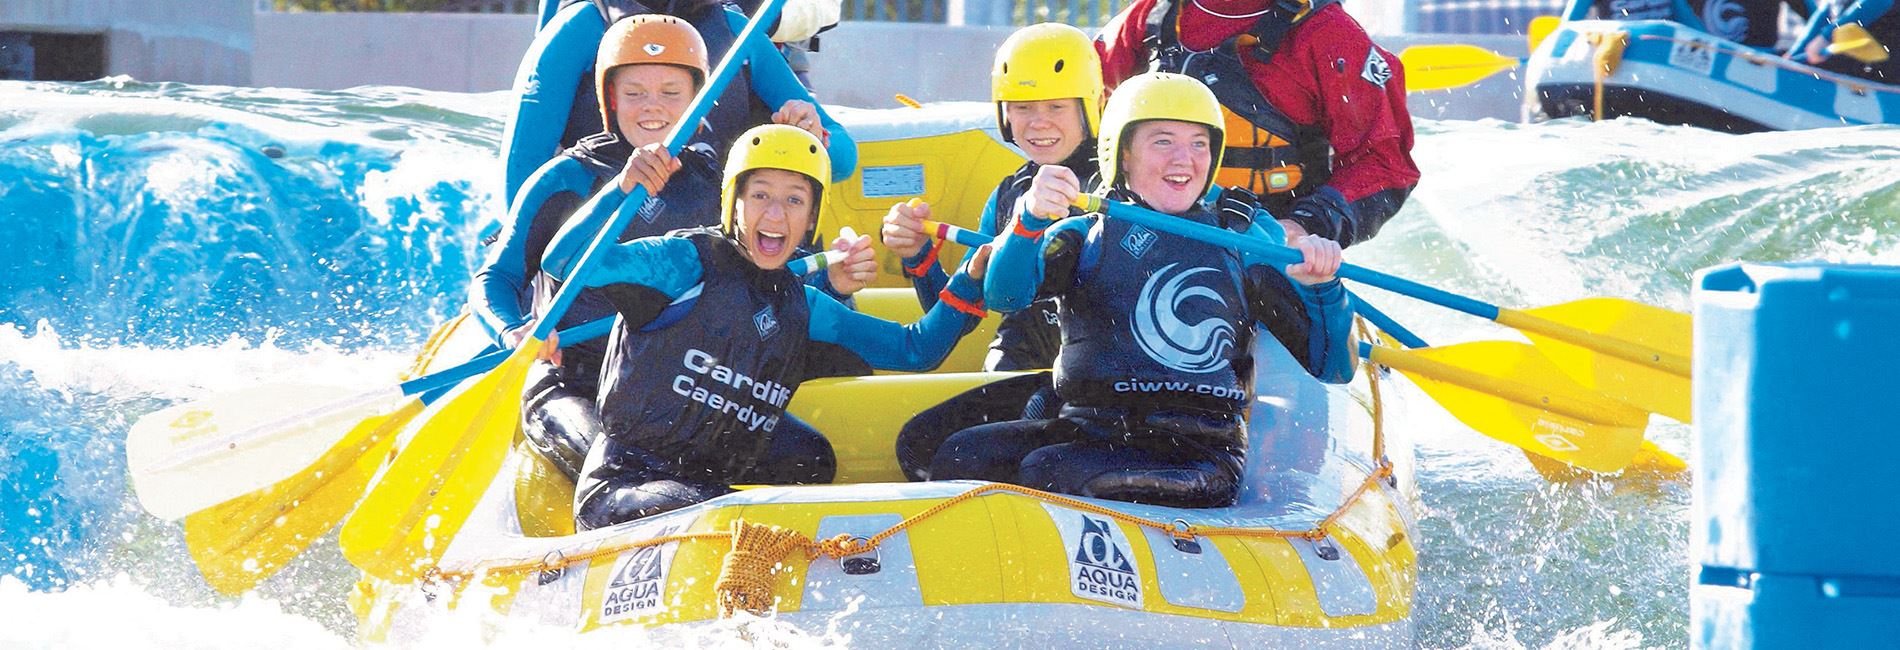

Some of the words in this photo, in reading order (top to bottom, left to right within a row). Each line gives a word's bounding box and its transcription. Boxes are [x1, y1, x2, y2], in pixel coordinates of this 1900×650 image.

[1114, 378, 1246, 401] ciww.com
[672, 374, 779, 433] Caerdyd
[1078, 566, 1138, 593] AQUA
[1079, 582, 1137, 602] DESIGN
[604, 598, 656, 617] DESIGN
